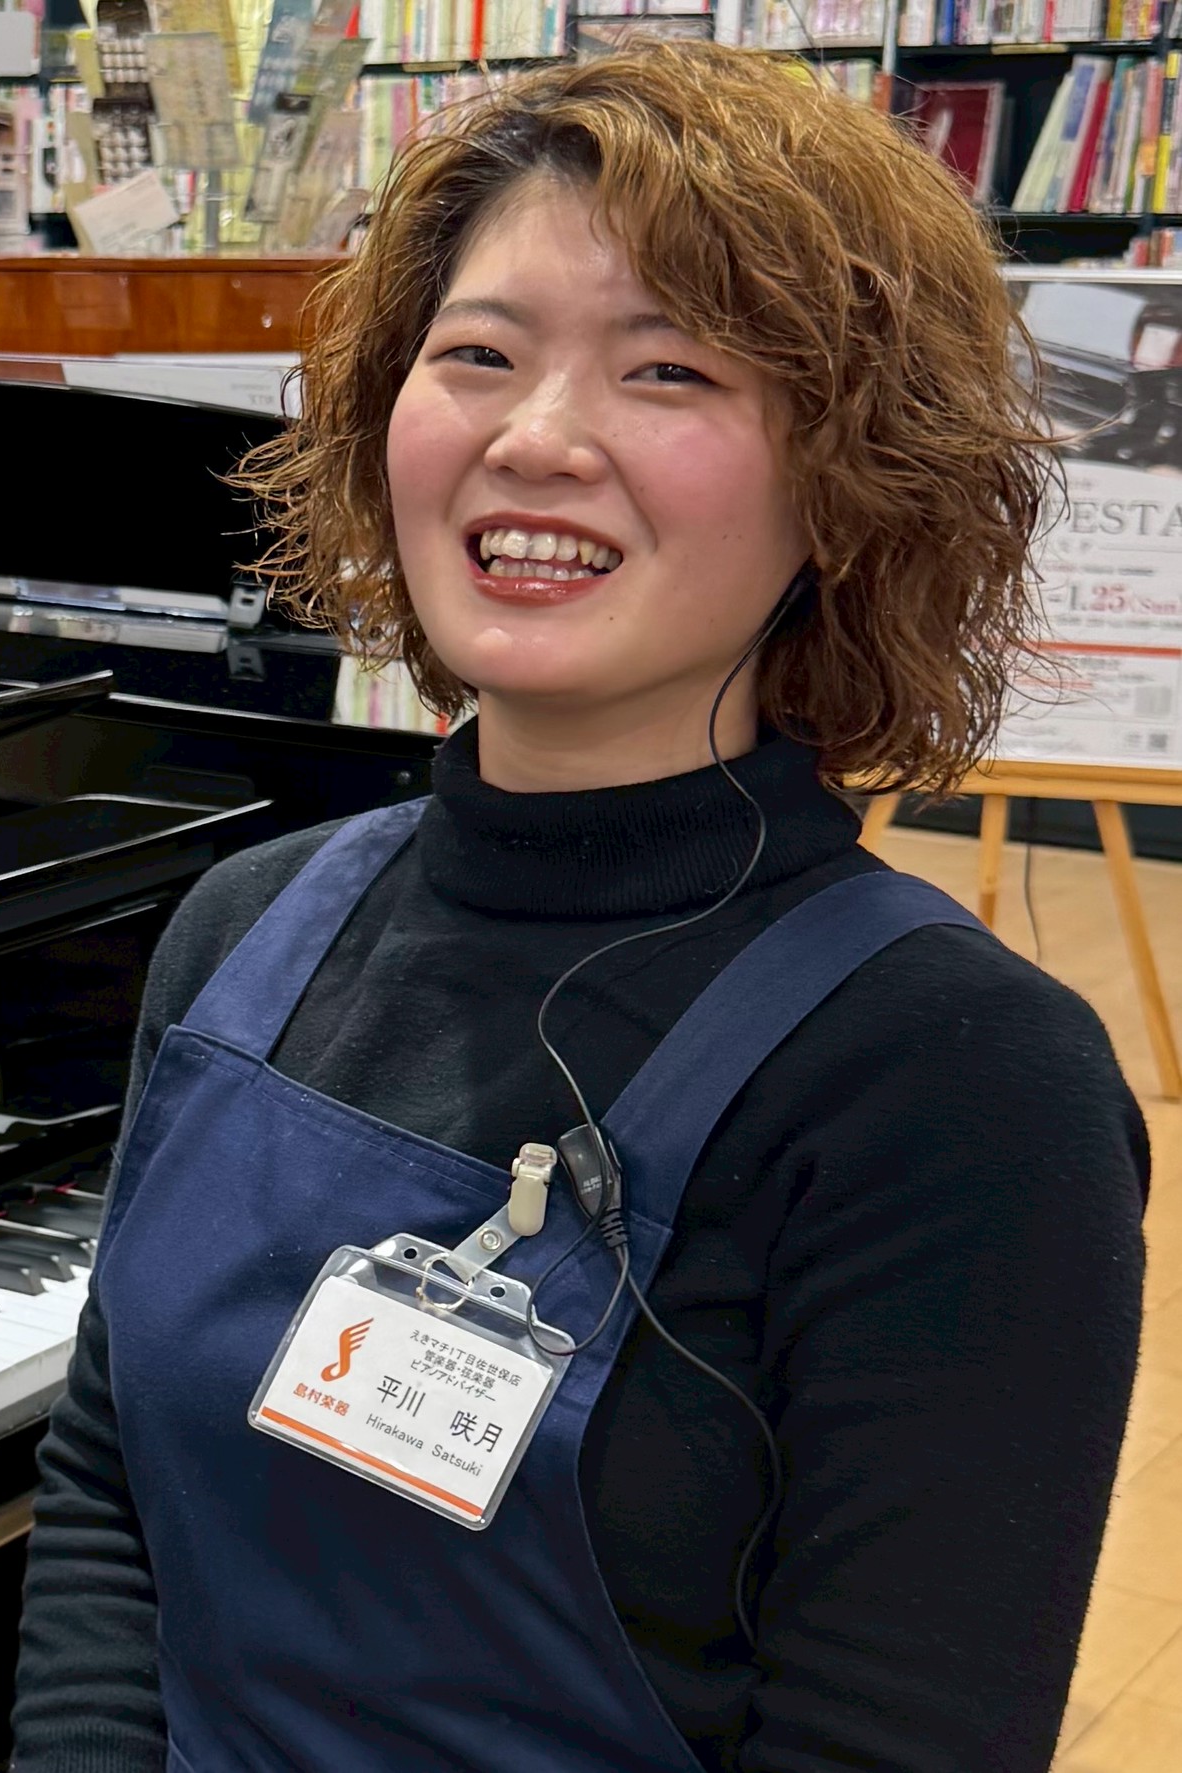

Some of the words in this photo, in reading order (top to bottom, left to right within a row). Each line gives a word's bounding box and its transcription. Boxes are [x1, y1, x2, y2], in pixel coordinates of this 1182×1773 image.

[292, 1382, 350, 1417] 島村楽器
[410, 1358, 496, 1402] ピアノアドバイザー
[376, 1374, 426, 1418] 平川
[449, 1408, 504, 1454] 咲月
[365, 1413, 424, 1450] Hirakawa
[431, 1444, 482, 1477] Satsuki
